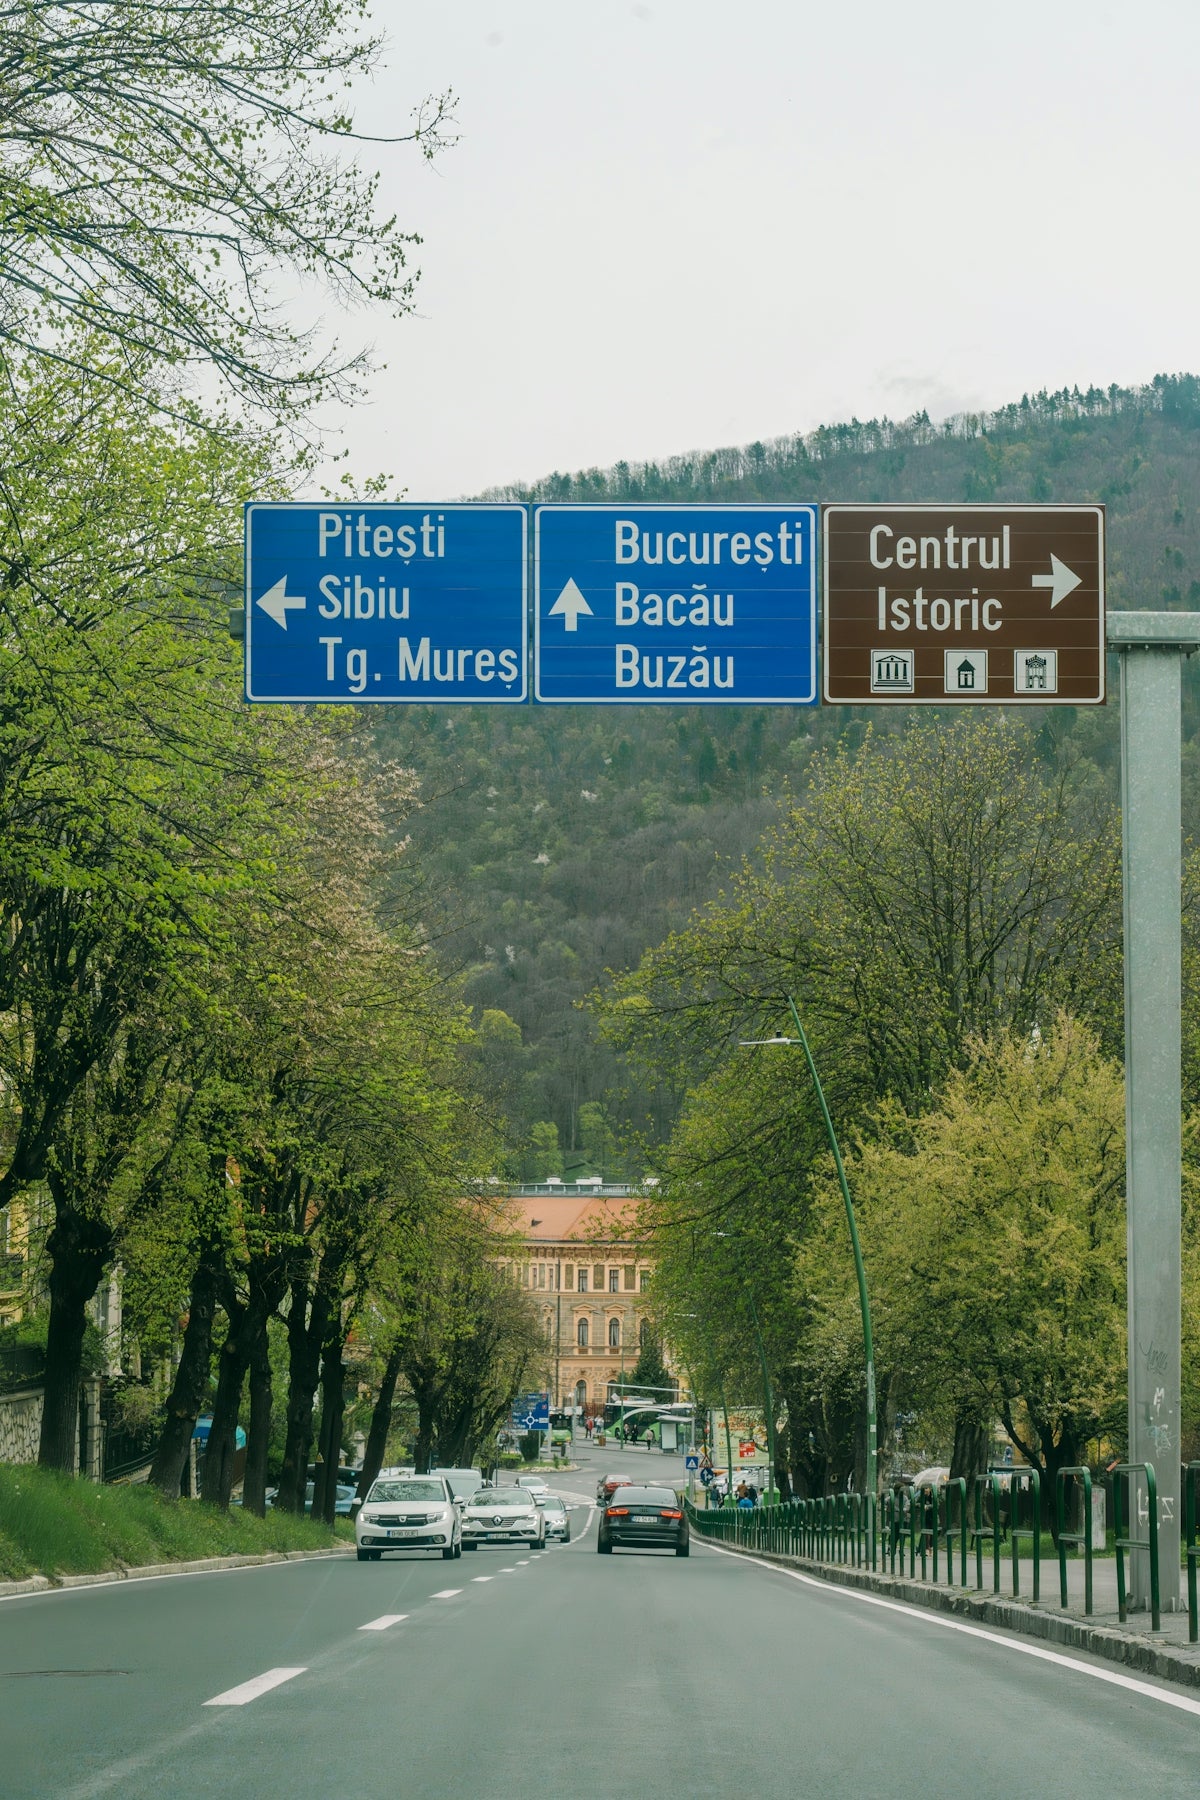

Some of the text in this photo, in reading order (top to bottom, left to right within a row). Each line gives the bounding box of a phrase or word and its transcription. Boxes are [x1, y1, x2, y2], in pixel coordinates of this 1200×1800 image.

[319, 513, 445, 566] Pitești
[615, 520, 802, 573] București
[869, 524, 1010, 569] Centrul
[318, 574, 410, 620] Sibiu
[615, 582, 734, 627] Bacău
[878, 585, 1003, 631] Istoric
[319, 637, 519, 693] Tg. Mureș
[615, 644, 734, 688] Buzău
